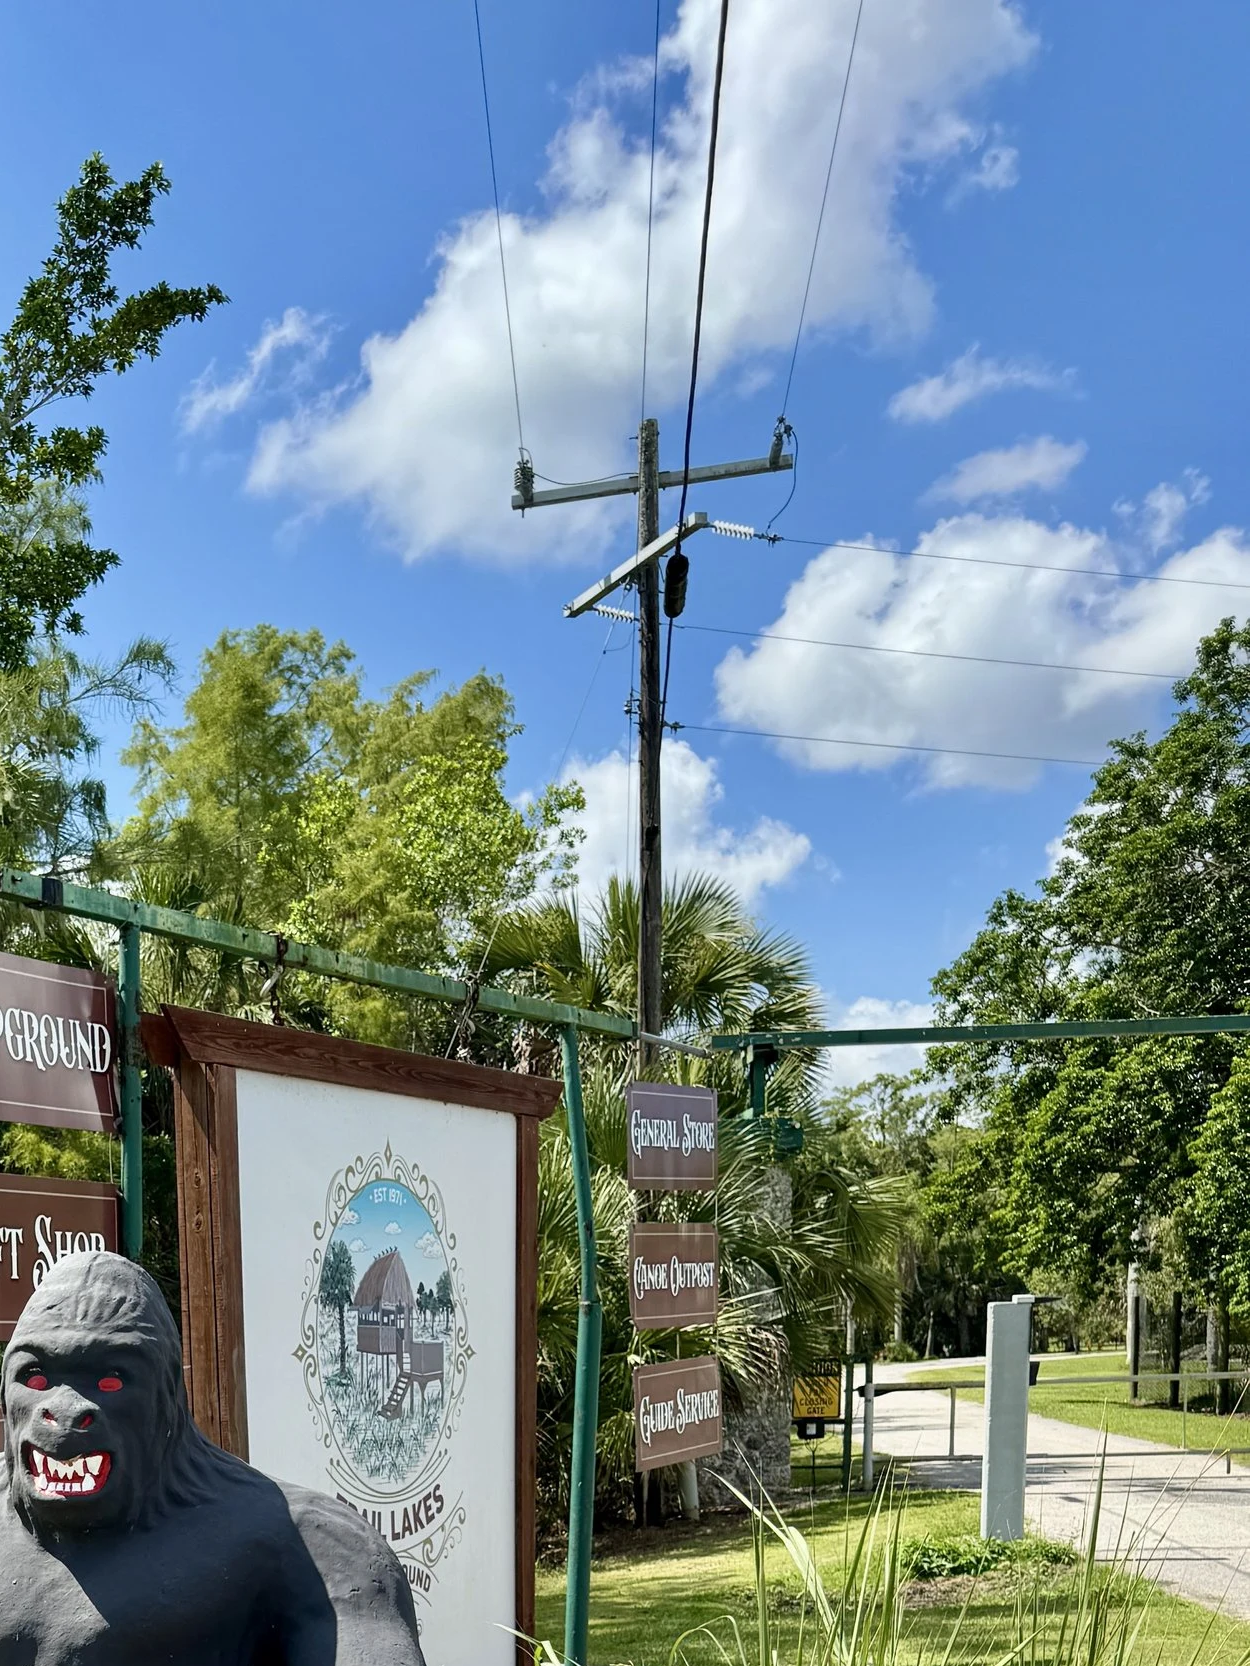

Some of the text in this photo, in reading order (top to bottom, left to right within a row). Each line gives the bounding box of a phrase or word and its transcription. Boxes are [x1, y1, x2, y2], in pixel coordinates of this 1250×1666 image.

[631, 1109, 715, 1159] GENERAL STORE
[373, 1187, 403, 1206] EST 1971
[633, 1255, 715, 1300] CANOE OUTPOST
[640, 1388, 720, 1447] GUIDE SERVICE
[391, 1483, 445, 1542] LAKES
